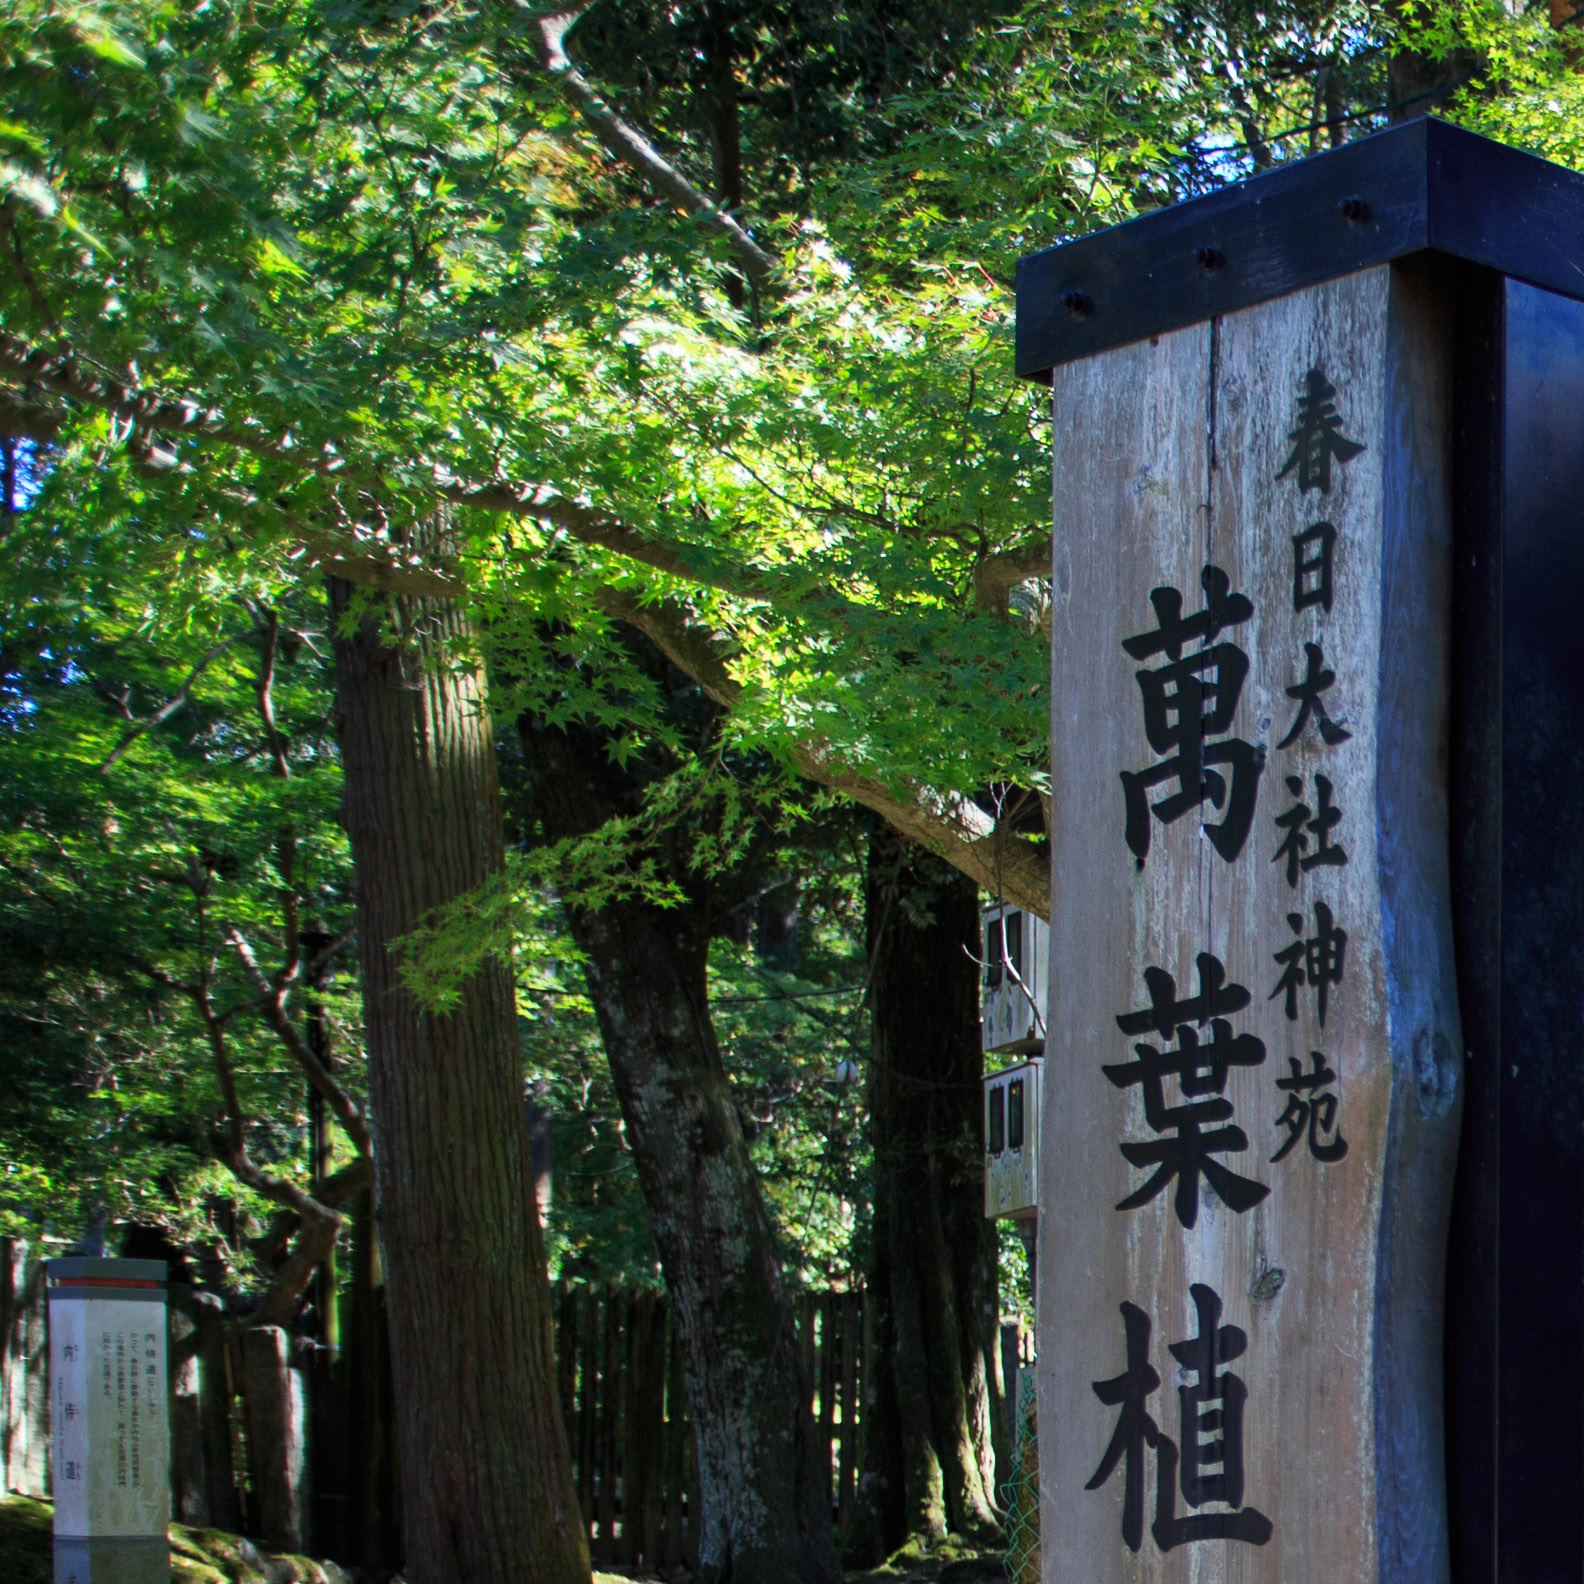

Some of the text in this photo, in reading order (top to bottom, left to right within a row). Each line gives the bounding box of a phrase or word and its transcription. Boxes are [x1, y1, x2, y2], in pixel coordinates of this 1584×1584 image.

[1268, 369, 1365, 1166] 春日大社神苑
